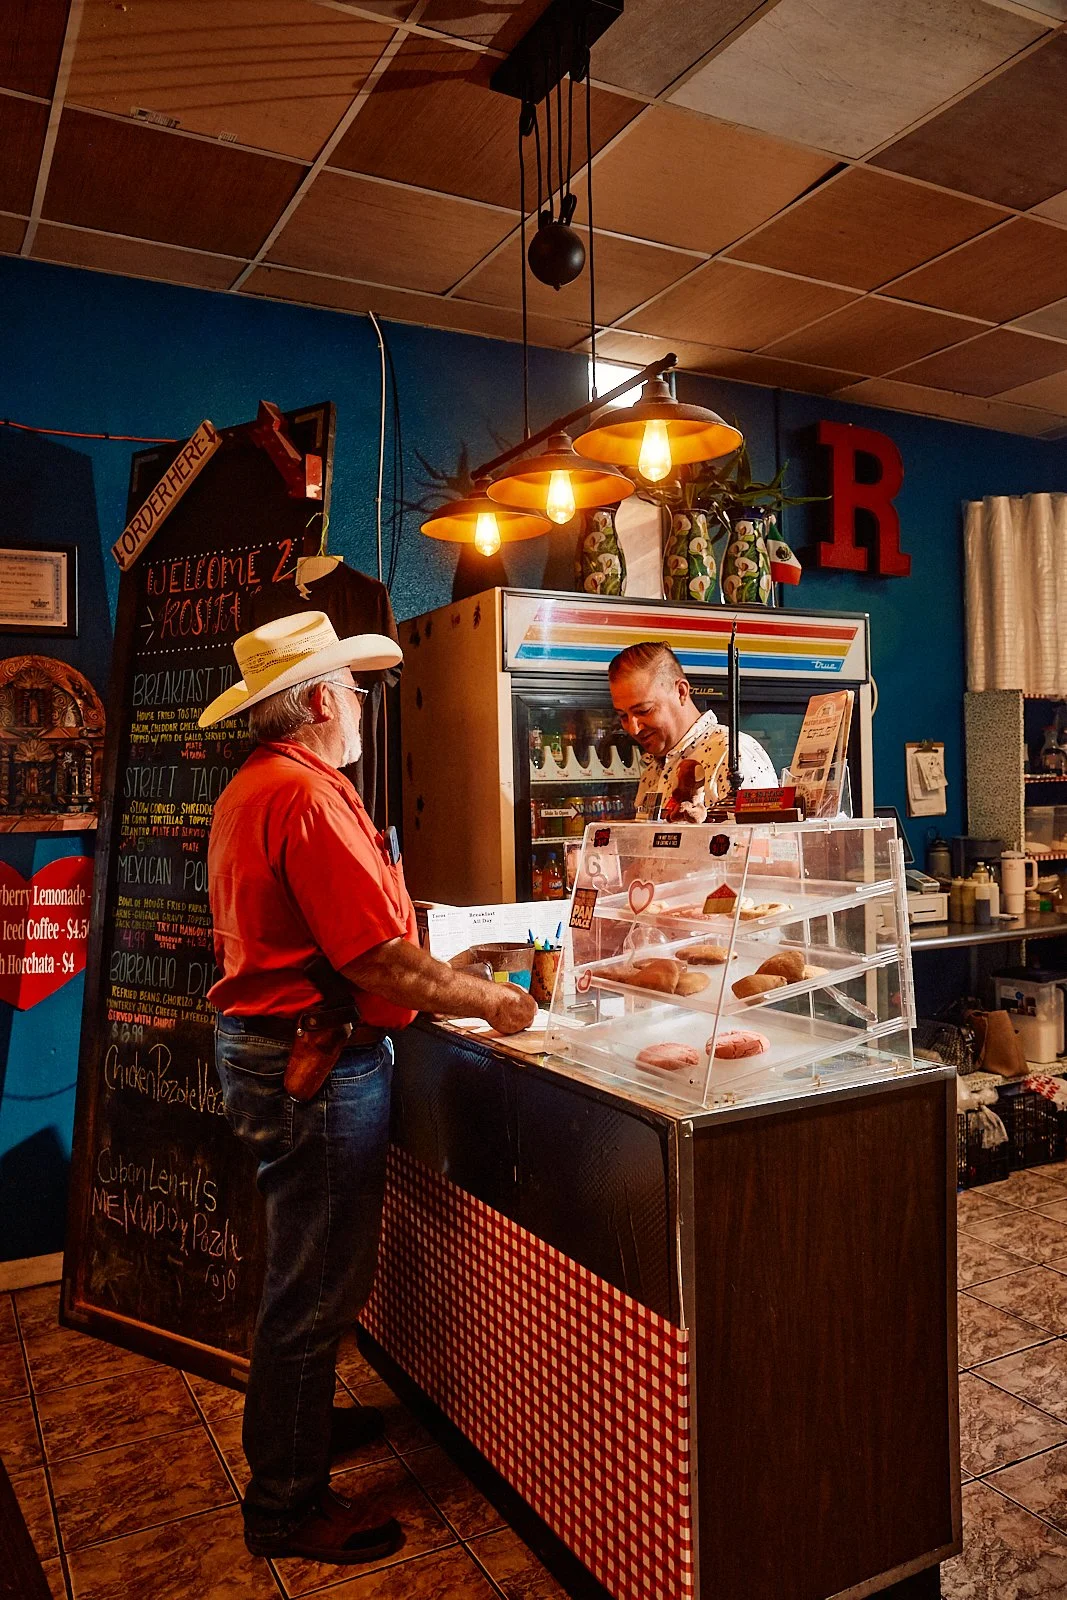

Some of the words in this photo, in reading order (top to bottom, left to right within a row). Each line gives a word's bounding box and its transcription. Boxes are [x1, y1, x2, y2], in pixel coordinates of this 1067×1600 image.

[121, 484, 174, 557] ORDER
[167, 434, 208, 491] HERE
[817, 419, 912, 577] R
[147, 549, 262, 596] WELCOME
[810, 660, 837, 670] true
[132, 667, 215, 706] BREAKFAST
[136, 710, 155, 722] HOUSE
[157, 710, 176, 720] FRIED
[150, 722, 178, 733] CHEDDAR
[220, 718, 238, 729] DONE
[129, 734, 150, 744] TOPPED
[204, 731, 227, 741] SERVED
[185, 742, 203, 750] PLATE
[189, 750, 207, 760] PAPAS
[123, 766, 178, 798] STREET
[129, 800, 149, 814] SLOW
[149, 802, 176, 815] COOKED
[121, 813, 130, 825] IN
[131, 814, 148, 825] CORN
[149, 815, 184, 825] TORTILLAS
[188, 815, 213, 826] TOPPE
[151, 825, 170, 837] PLATE
[171, 826, 180, 837] IS
[181, 826, 206, 838] SERVED
[182, 842, 199, 853] PLATE
[117, 855, 172, 885] MEXICAN
[0, 884, 32, 911] berry
[33, 884, 86, 906] Lemonade
[143, 898, 165, 909] HOUSE
[166, 900, 187, 911] FRIED
[188, 903, 208, 913] PAPAS
[187, 914, 212, 926] TOPPED
[571, 904, 594, 920] PAN
[2, 918, 25, 941] Iced
[26, 916, 59, 941] Coffee
[156, 921, 171, 933] TRY
[172, 923, 179, 934] IT
[180, 924, 213, 938] HANGOVER
[570, 917, 591, 928] DULCE
[7, 951, 55, 975] Horchata
[62, 950, 75, 975] $4
[109, 950, 177, 989] BORRACHO
[111, 985, 138, 1000] REFRIED
[162, 993, 194, 1007] CHORIZO
[195, 999, 204, 1011] &
[107, 1008, 133, 1023] SERVED
[133, 1012, 152, 1027] WITH
[137, 1002, 154, 1014] JACK
[155, 1005, 179, 1018] CHEESE
[181, 1010, 209, 1024] LAYERED
[104, 1044, 157, 1101] Chicken
[97, 1147, 147, 1192] Cuban
[149, 1157, 217, 1212] Lentils
